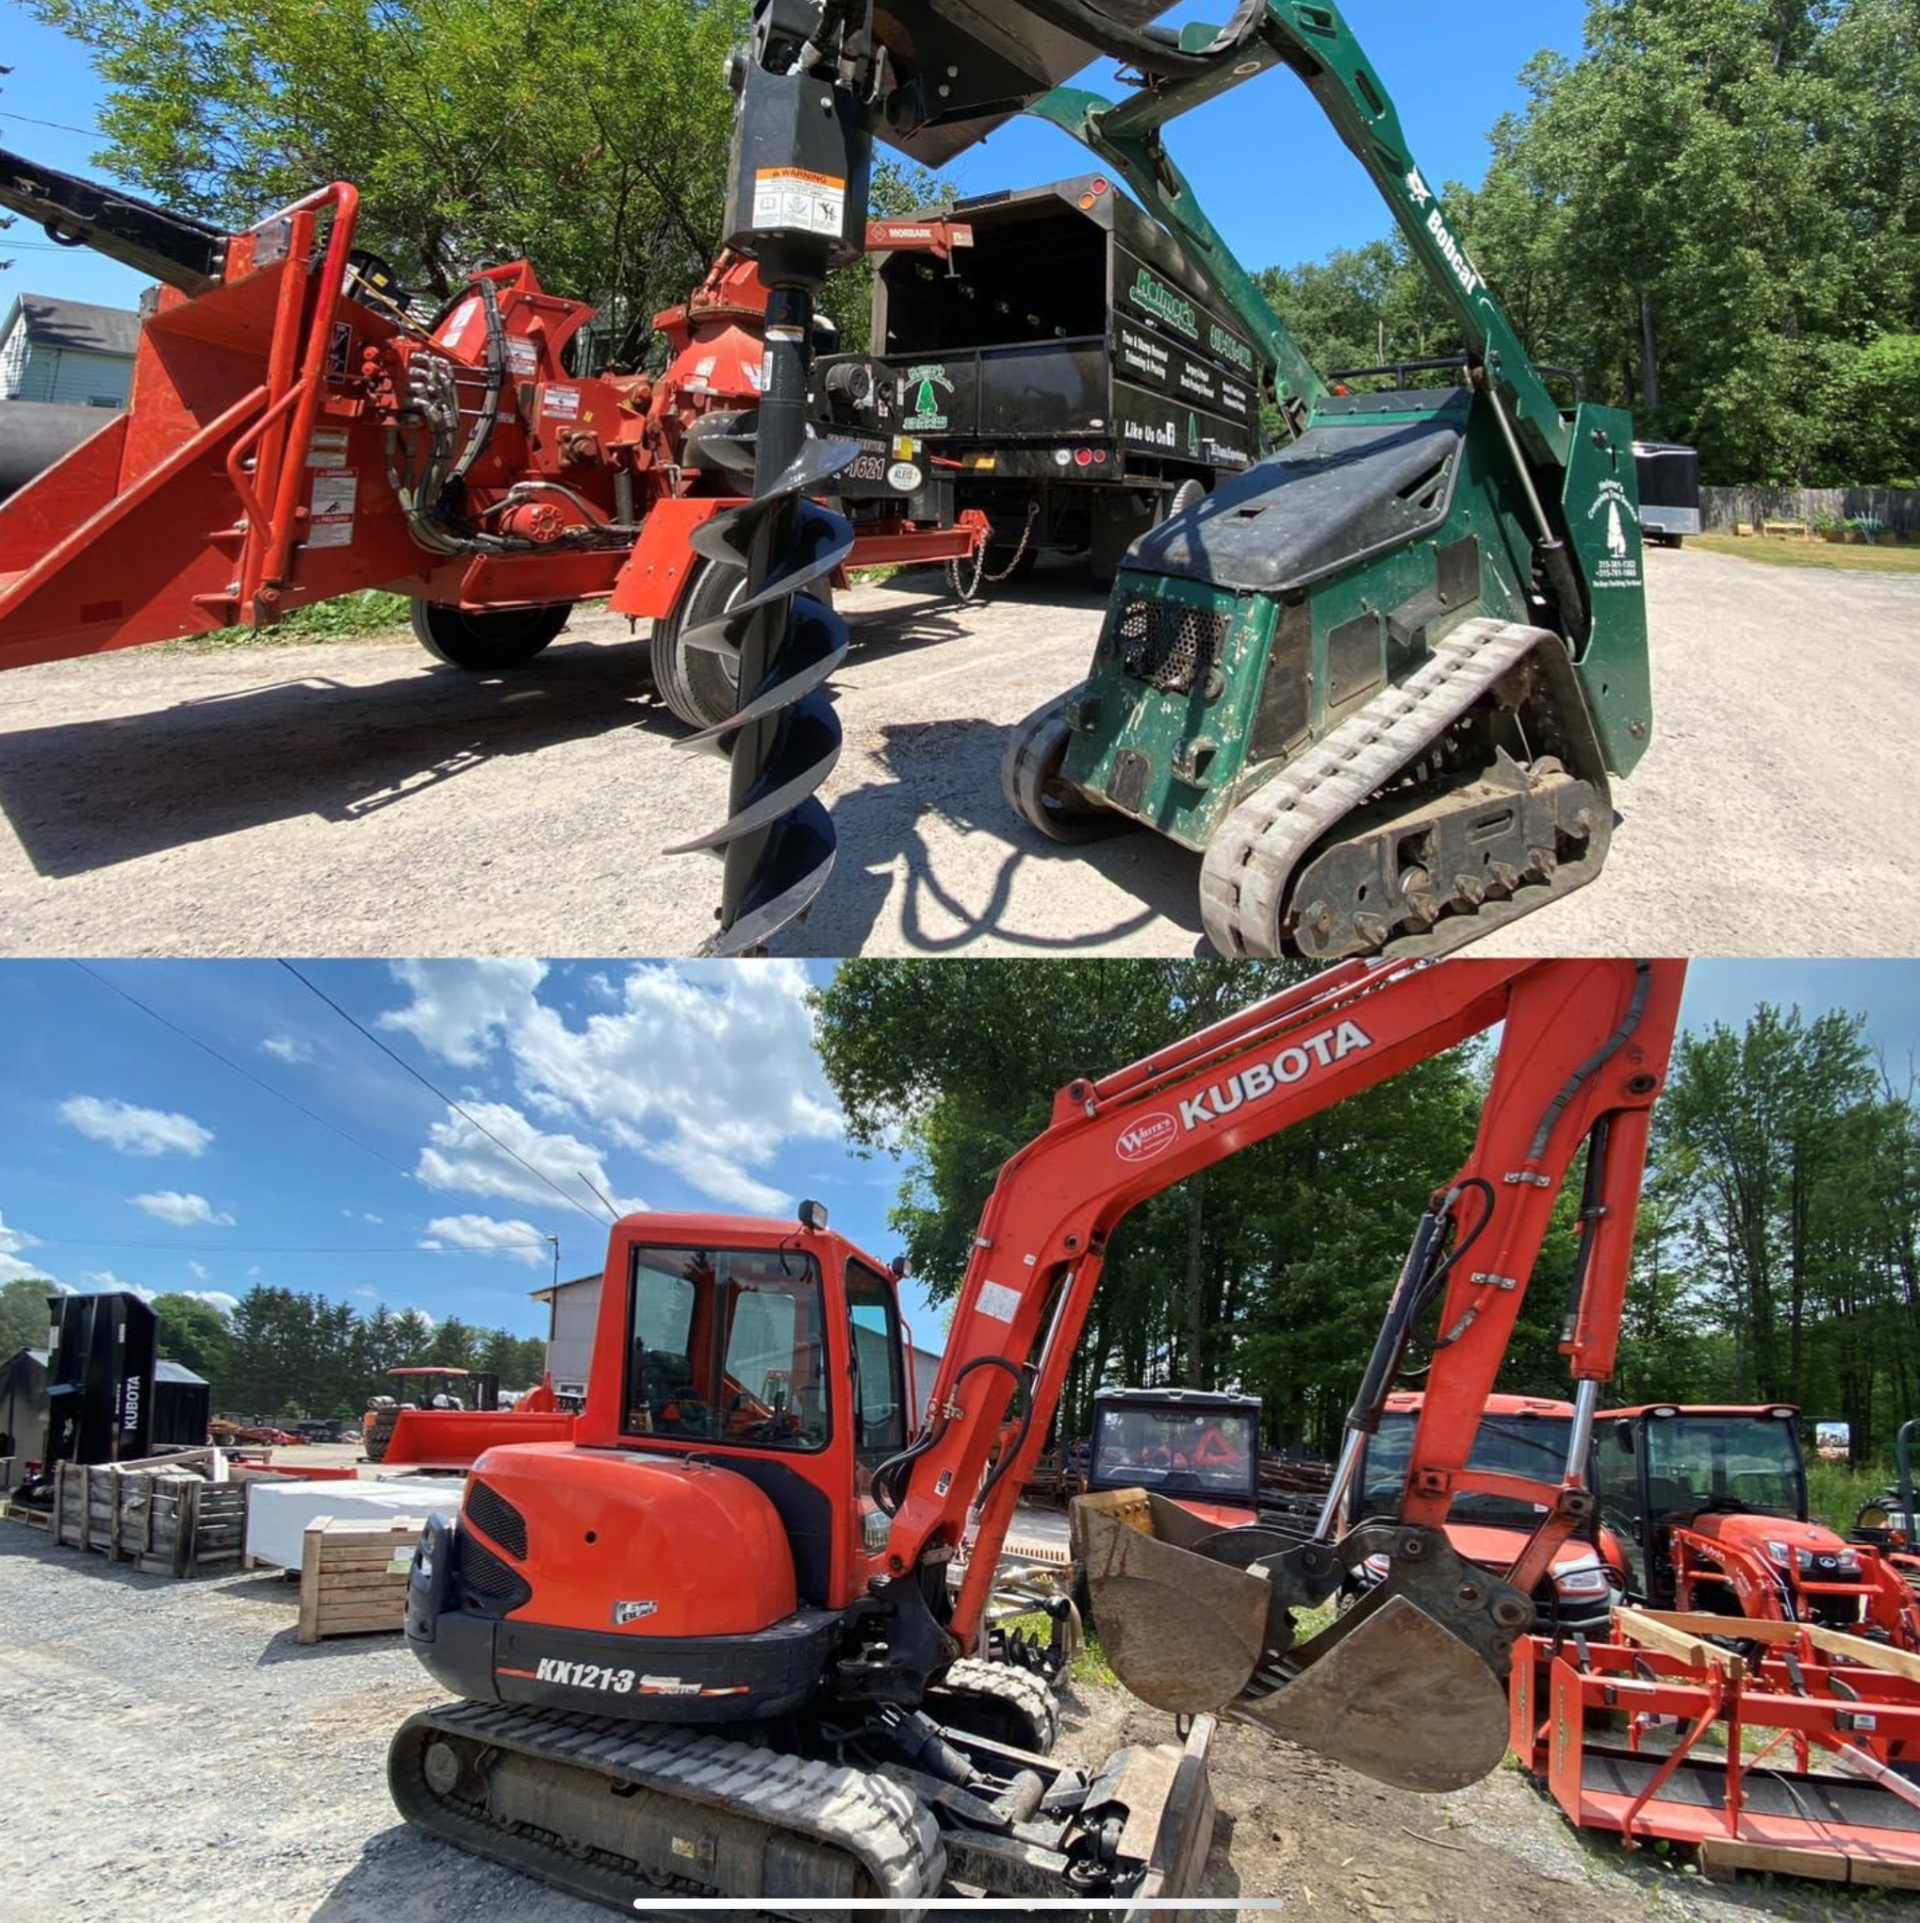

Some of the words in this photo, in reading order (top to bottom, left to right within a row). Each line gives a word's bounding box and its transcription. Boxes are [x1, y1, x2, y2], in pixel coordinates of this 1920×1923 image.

[782, 169, 827, 184] WARNING
[888, 228, 932, 238] MORBARK
[1427, 208, 1477, 296] Bobcat
[1125, 420, 1143, 441] Like
[1145, 425, 1155, 443] Us
[1156, 428, 1166, 446] On
[1178, 1019, 1374, 1131] KUBOTA
[124, 1375, 141, 1430] KUBOTA
[535, 1657, 637, 1694] KX121-3
